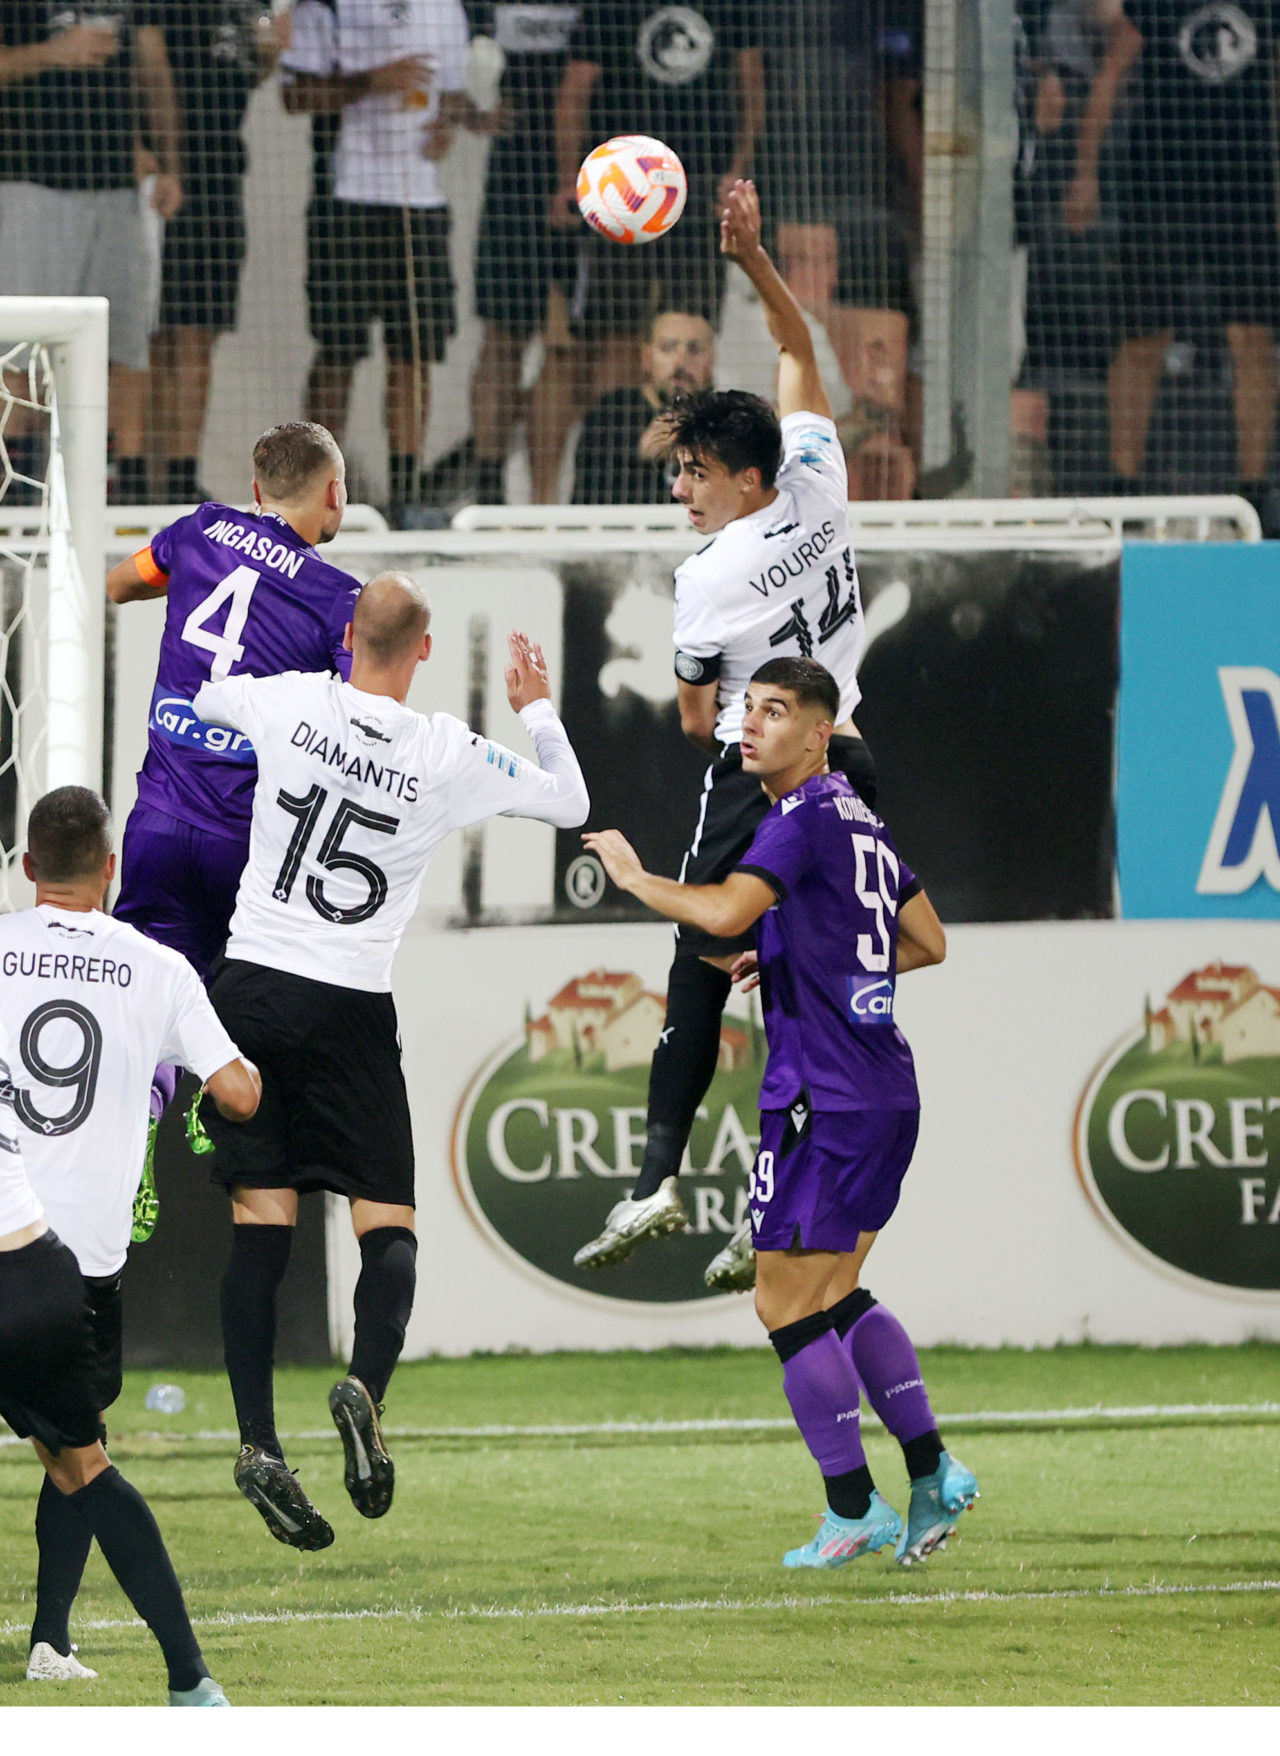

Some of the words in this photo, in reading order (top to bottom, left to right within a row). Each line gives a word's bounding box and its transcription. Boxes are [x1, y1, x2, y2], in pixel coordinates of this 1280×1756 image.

[202, 520, 304, 579] INGASON
[749, 521, 835, 597] VOUROS
[181, 564, 261, 683] 4
[290, 721, 420, 803] DIAMANTIS
[272, 783, 400, 925] 15
[851, 832, 900, 973] 59
[3, 951, 132, 988] GUERRERO
[14, 999, 103, 1136] 9
